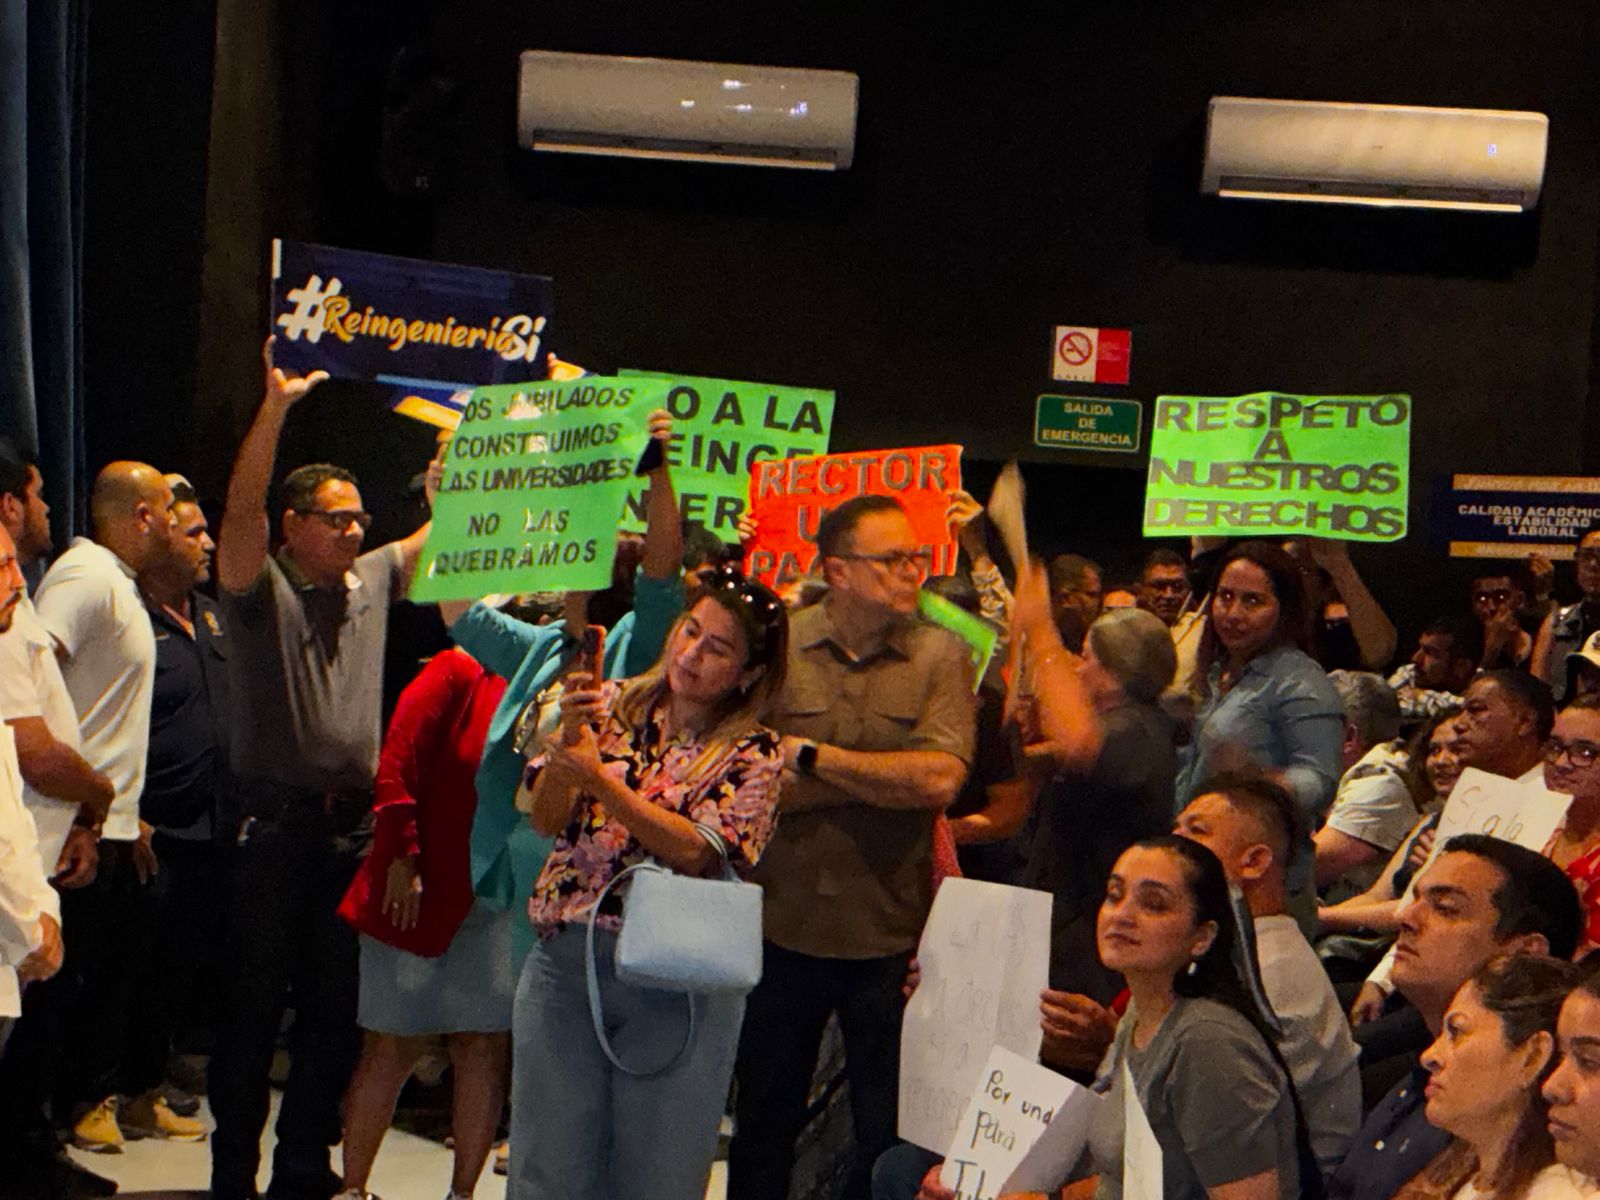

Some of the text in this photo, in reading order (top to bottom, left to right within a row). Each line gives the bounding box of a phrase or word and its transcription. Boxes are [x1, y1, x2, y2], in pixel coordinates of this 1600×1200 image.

[463, 397, 493, 423] OS
[667, 386, 823, 434] O A LA
[1064, 402, 1113, 416] SALIDA
[1078, 417, 1096, 429] DE
[1157, 396, 1408, 432] RESPETO
[455, 422, 623, 459] CONSTRUIMOS
[1042, 428, 1132, 446] EMERGENCIA
[1253, 430, 1292, 461] A
[482, 458, 633, 492] UNIVERSIDADES
[759, 453, 948, 496] RECTOR
[1150, 457, 1400, 494] NUESTROS
[467, 508, 570, 537] NO LAS
[1147, 498, 1405, 537] DERECHOS
[1458, 504, 1600, 519] CALIDAD ACADÉMIC
[1493, 515, 1591, 528] ESTABILIDAD
[1508, 526, 1578, 537] LABORAL
[434, 539, 597, 575] QUEBRAMOS
[985, 1069, 1011, 1105] Por
